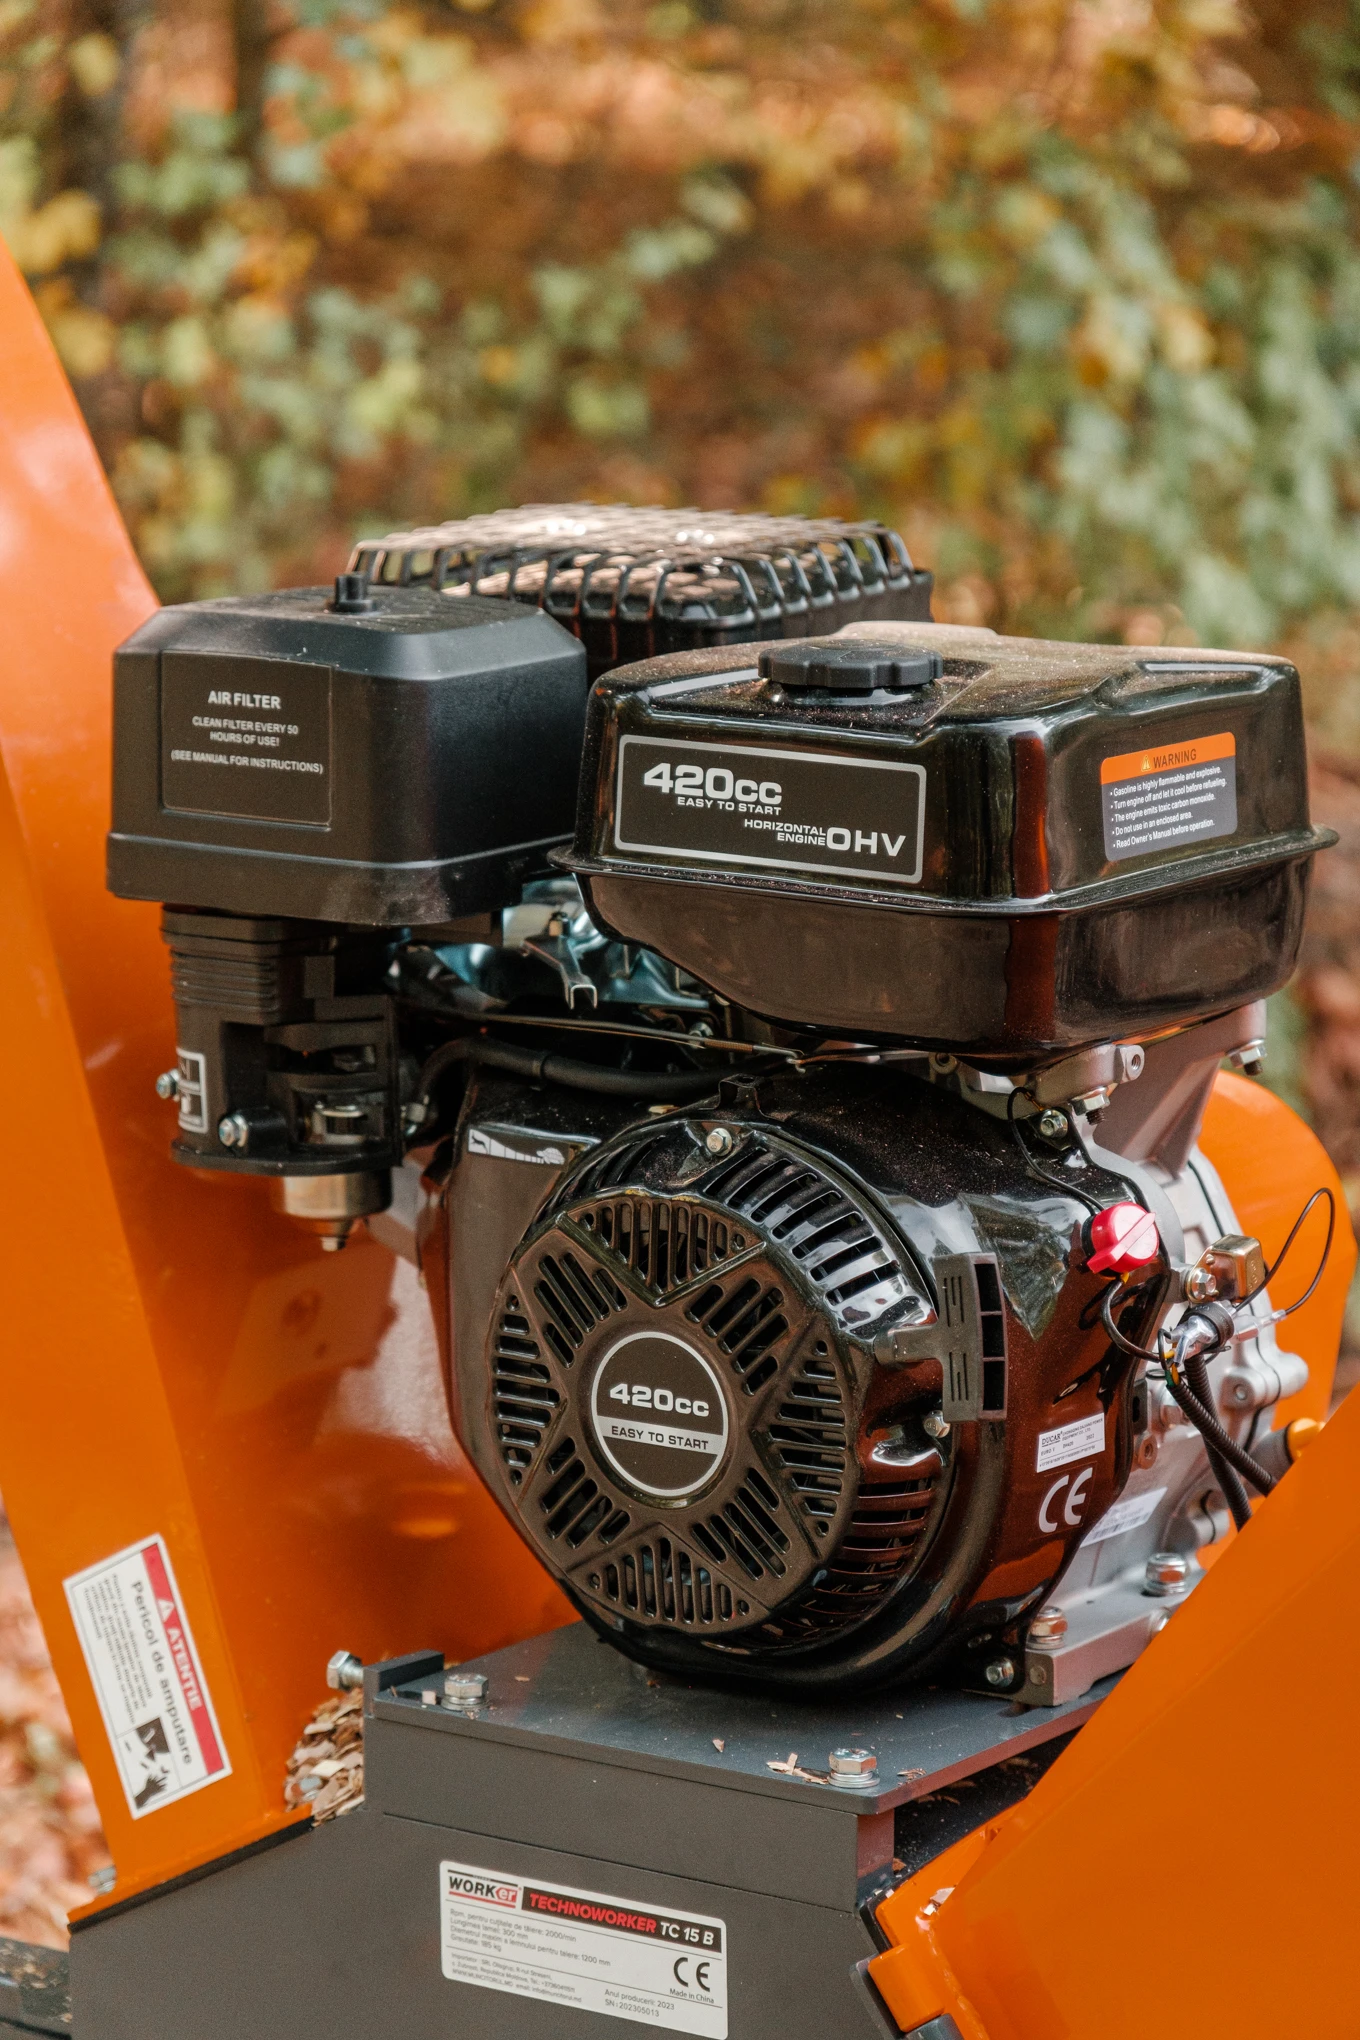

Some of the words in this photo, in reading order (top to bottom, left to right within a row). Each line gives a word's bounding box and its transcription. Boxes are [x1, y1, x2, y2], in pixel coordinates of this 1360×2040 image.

[208, 690, 231, 705] AIR
[233, 692, 281, 709] FILTER
[192, 715, 221, 728] CLEAN
[222, 718, 253, 731] FILTER
[254, 721, 286, 734] EVERY
[287, 724, 298, 735] 50
[210, 731, 242, 744] HOURS
[243, 734, 256, 744] OF
[257, 735, 280, 747] USE!
[171, 749, 191, 762] (SEE
[192, 751, 229, 765] MANUAL
[229, 755, 249, 766] FOR
[250, 758, 324, 775] INSTRUCTIONS)
[1153, 748, 1197, 769] WARNING
[643, 762, 782, 805] 420cc
[1113, 784, 1137, 797] Gasoline
[1137, 782, 1142, 791] is
[1142, 779, 1159, 791] highly
[1158, 773, 1186, 786] flammable
[1186, 770, 1196, 780] and
[1114, 800, 1126, 809] Turn
[1127, 796, 1144, 808] engine
[1152, 791, 1162, 800] and
[1162, 788, 1170, 798] let
[1170, 788, 1174, 796] it
[1174, 785, 1185, 796] cool
[1186, 782, 1203, 793] before
[677, 796, 713, 809] EASY
[717, 800, 735, 811] TO
[738, 803, 782, 816] START
[1115, 813, 1125, 822] The
[1125, 808, 1143, 820] engine
[1144, 805, 1157, 815] emits
[1158, 802, 1171, 813] toxic
[1171, 798, 1189, 809] carbon
[1115, 827, 1124, 836] Do
[1124, 824, 1133, 834] not
[1133, 823, 1142, 832] use
[1143, 820, 1149, 829] in
[1149, 820, 1156, 828] an
[1156, 813, 1179, 825] enclosed
[1179, 811, 1193, 821] area.
[744, 818, 826, 836] HORIZONTAL
[826, 826, 906, 857] OHV
[777, 832, 826, 846] ENGINE
[1116, 838, 1131, 849] Read
[1131, 833, 1153, 845] Owner's
[1153, 827, 1172, 840] Manual
[1172, 824, 1189, 835] before
[609, 1383, 709, 1417] 420cc
[611, 1425, 644, 1439] EASY
[648, 1431, 664, 1443] TO
[668, 1435, 709, 1451] START
[1038, 1467, 1093, 1533] CE
[131, 1580, 159, 1647] Pericol
[152, 1650, 165, 1674] de
[159, 1679, 192, 1765] amputare
[450, 1917, 480, 1931] Lungimea
[502, 1928, 515, 1937] 300
[516, 1931, 528, 1940] mm
[529, 1893, 657, 1934] TECHNOWORKER
[660, 1921, 680, 1939] TC
[684, 1926, 700, 1943] 15
[702, 1931, 715, 1946] B
[514, 1923, 522, 1931] de
[545, 1929, 577, 1943] 2000/min
[493, 1942, 501, 1952] kg
[581, 1953, 597, 1964] 1200
[599, 1958, 611, 1967] mm
[673, 1956, 711, 1993] CE
[604, 1988, 620, 1998] Anul
[657, 2000, 675, 2010] 2023
[669, 1987, 688, 1998] Made
[688, 1991, 695, 1999] in
[695, 1993, 715, 2004] China
